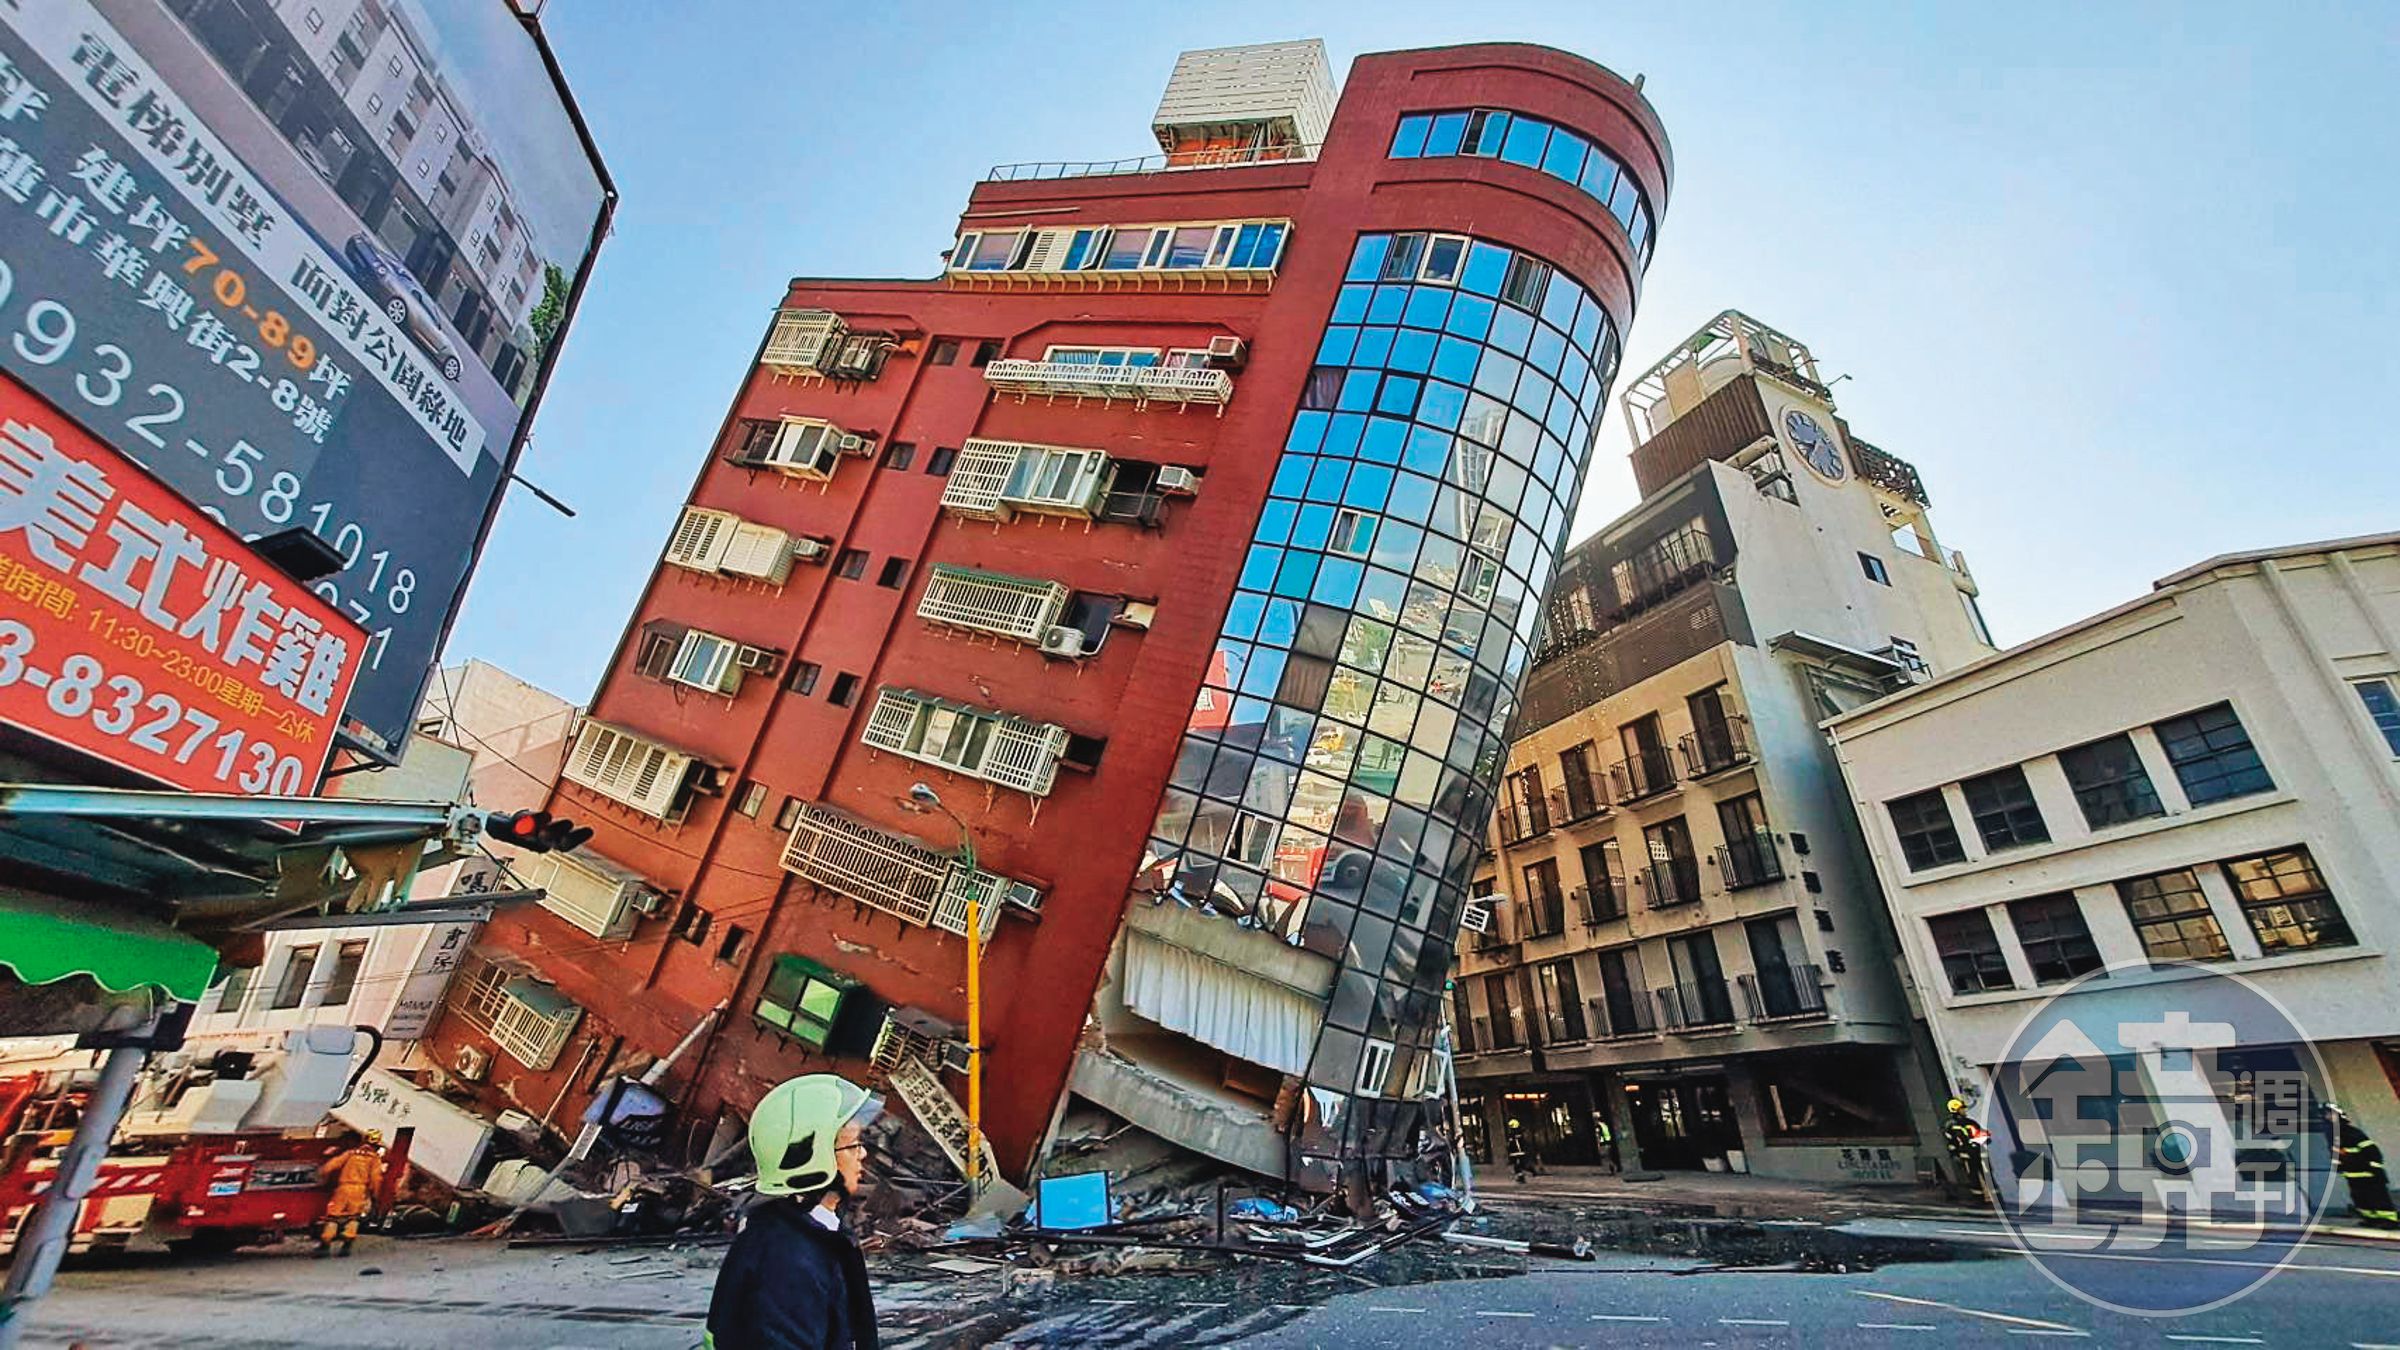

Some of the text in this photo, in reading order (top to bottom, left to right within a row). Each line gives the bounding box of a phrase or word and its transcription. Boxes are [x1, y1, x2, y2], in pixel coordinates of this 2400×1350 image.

[68, 143, 352, 401] 建坪70-89坪
[71, 33, 277, 250] 電梯別墅
[289, 254, 467, 452] 面對公園綠地
[0, 258, 416, 614] 932-581018
[0, 418, 348, 717] 美式炸雞
